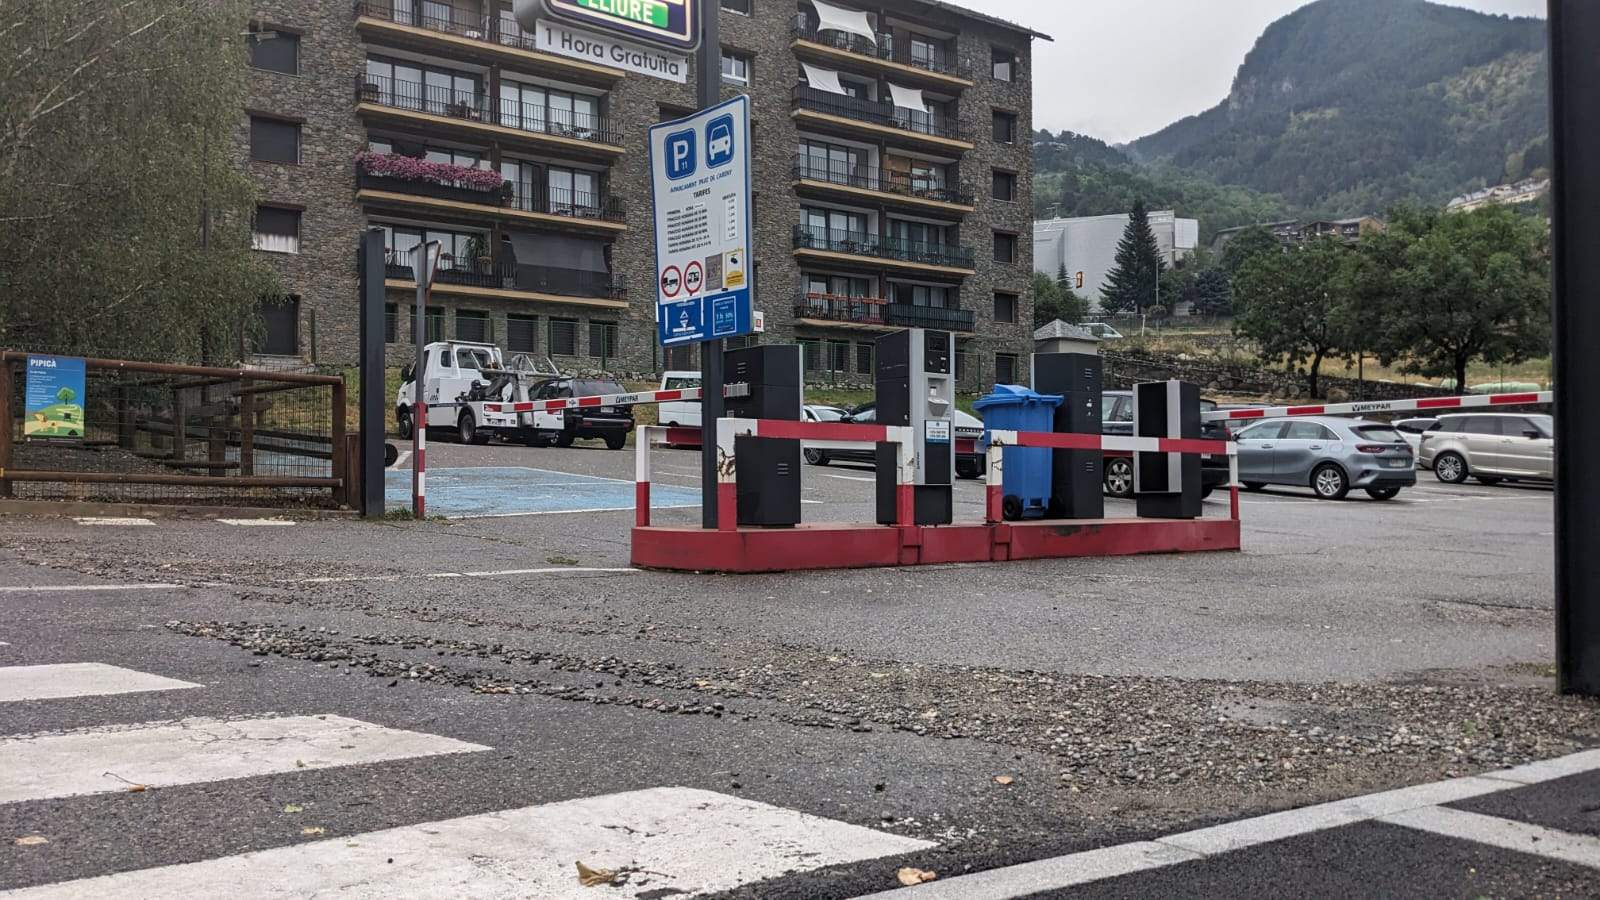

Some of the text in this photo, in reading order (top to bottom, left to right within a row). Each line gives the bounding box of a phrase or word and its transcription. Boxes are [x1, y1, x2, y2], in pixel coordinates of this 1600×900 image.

[546, 28, 678, 76] 1 Hora Gratuïta
[673, 140, 689, 172] P
[693, 187, 711, 198] TARIFES
[30, 358, 57, 368] PIPICÀ
[1361, 403, 1391, 411] MEYPAR
